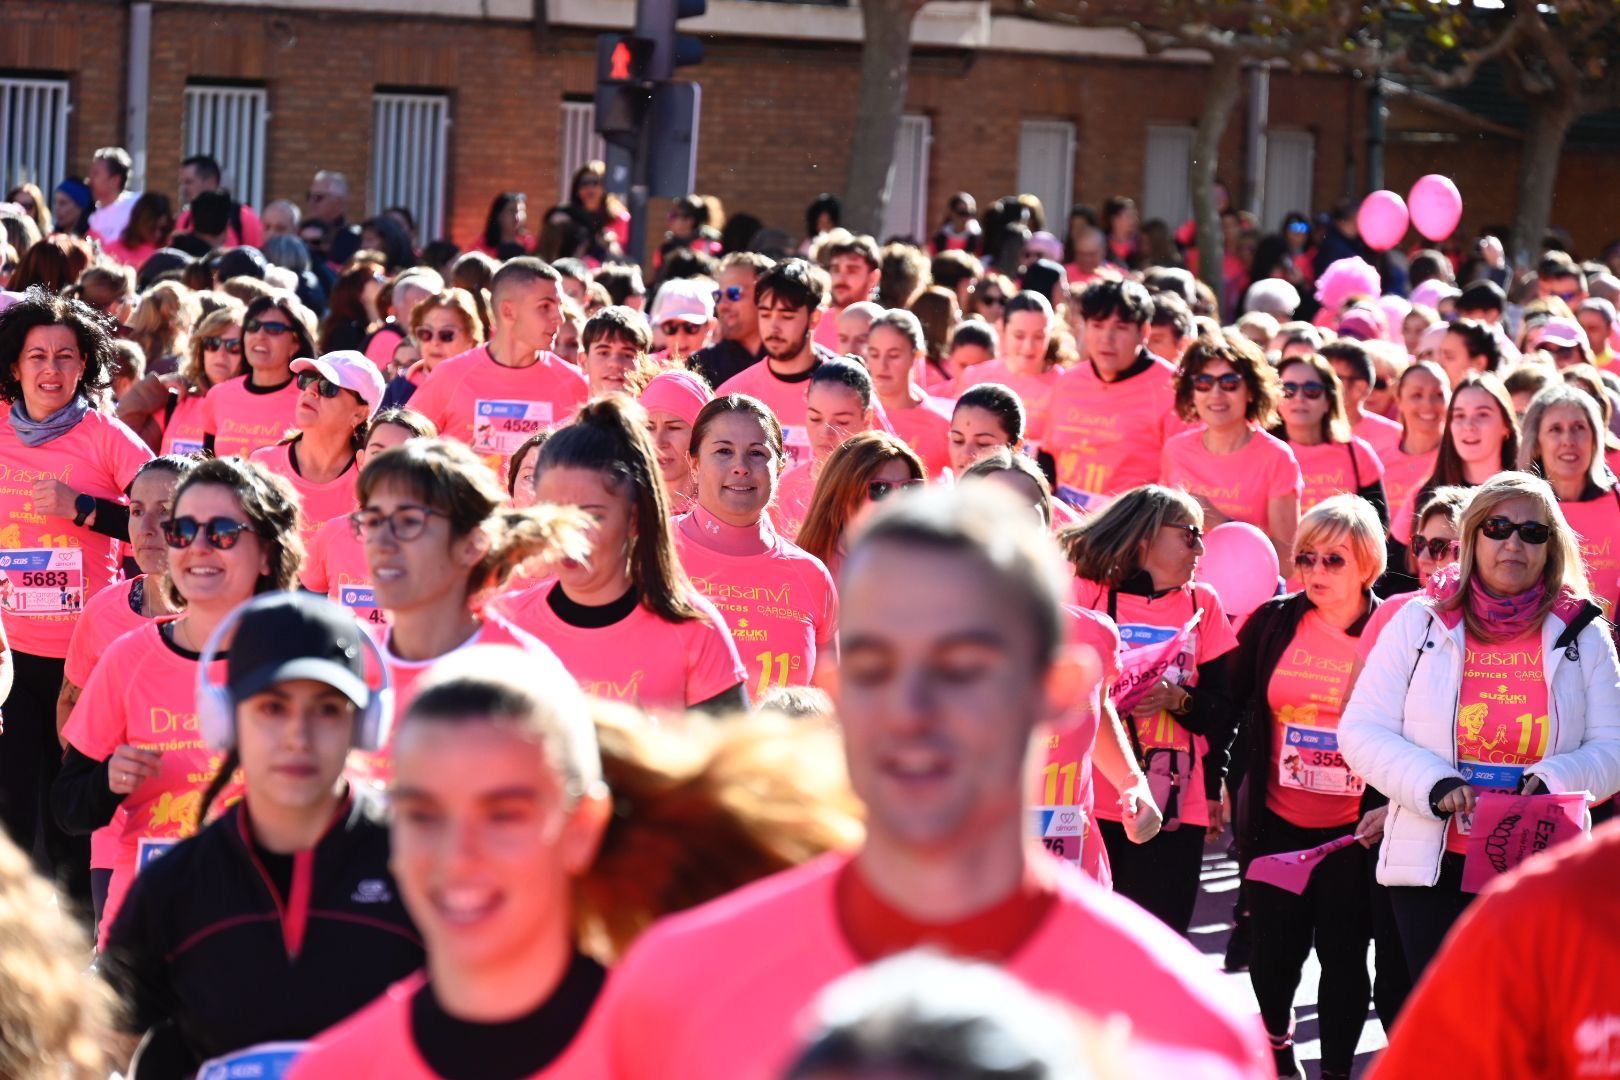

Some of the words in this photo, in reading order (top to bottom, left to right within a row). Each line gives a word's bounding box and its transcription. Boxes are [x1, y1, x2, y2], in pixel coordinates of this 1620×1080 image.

[503, 419, 540, 432] 4524
[22, 571, 68, 586] 5683
[689, 576, 791, 605] Drasanvi
[731, 629, 768, 637] UZUKI
[1292, 648, 1353, 673] Drasa
[1465, 644, 1543, 666] Drasanv
[1480, 691, 1527, 701] SUZUKI
[1312, 751, 1347, 768] 355
[1461, 767, 1473, 780] hp
